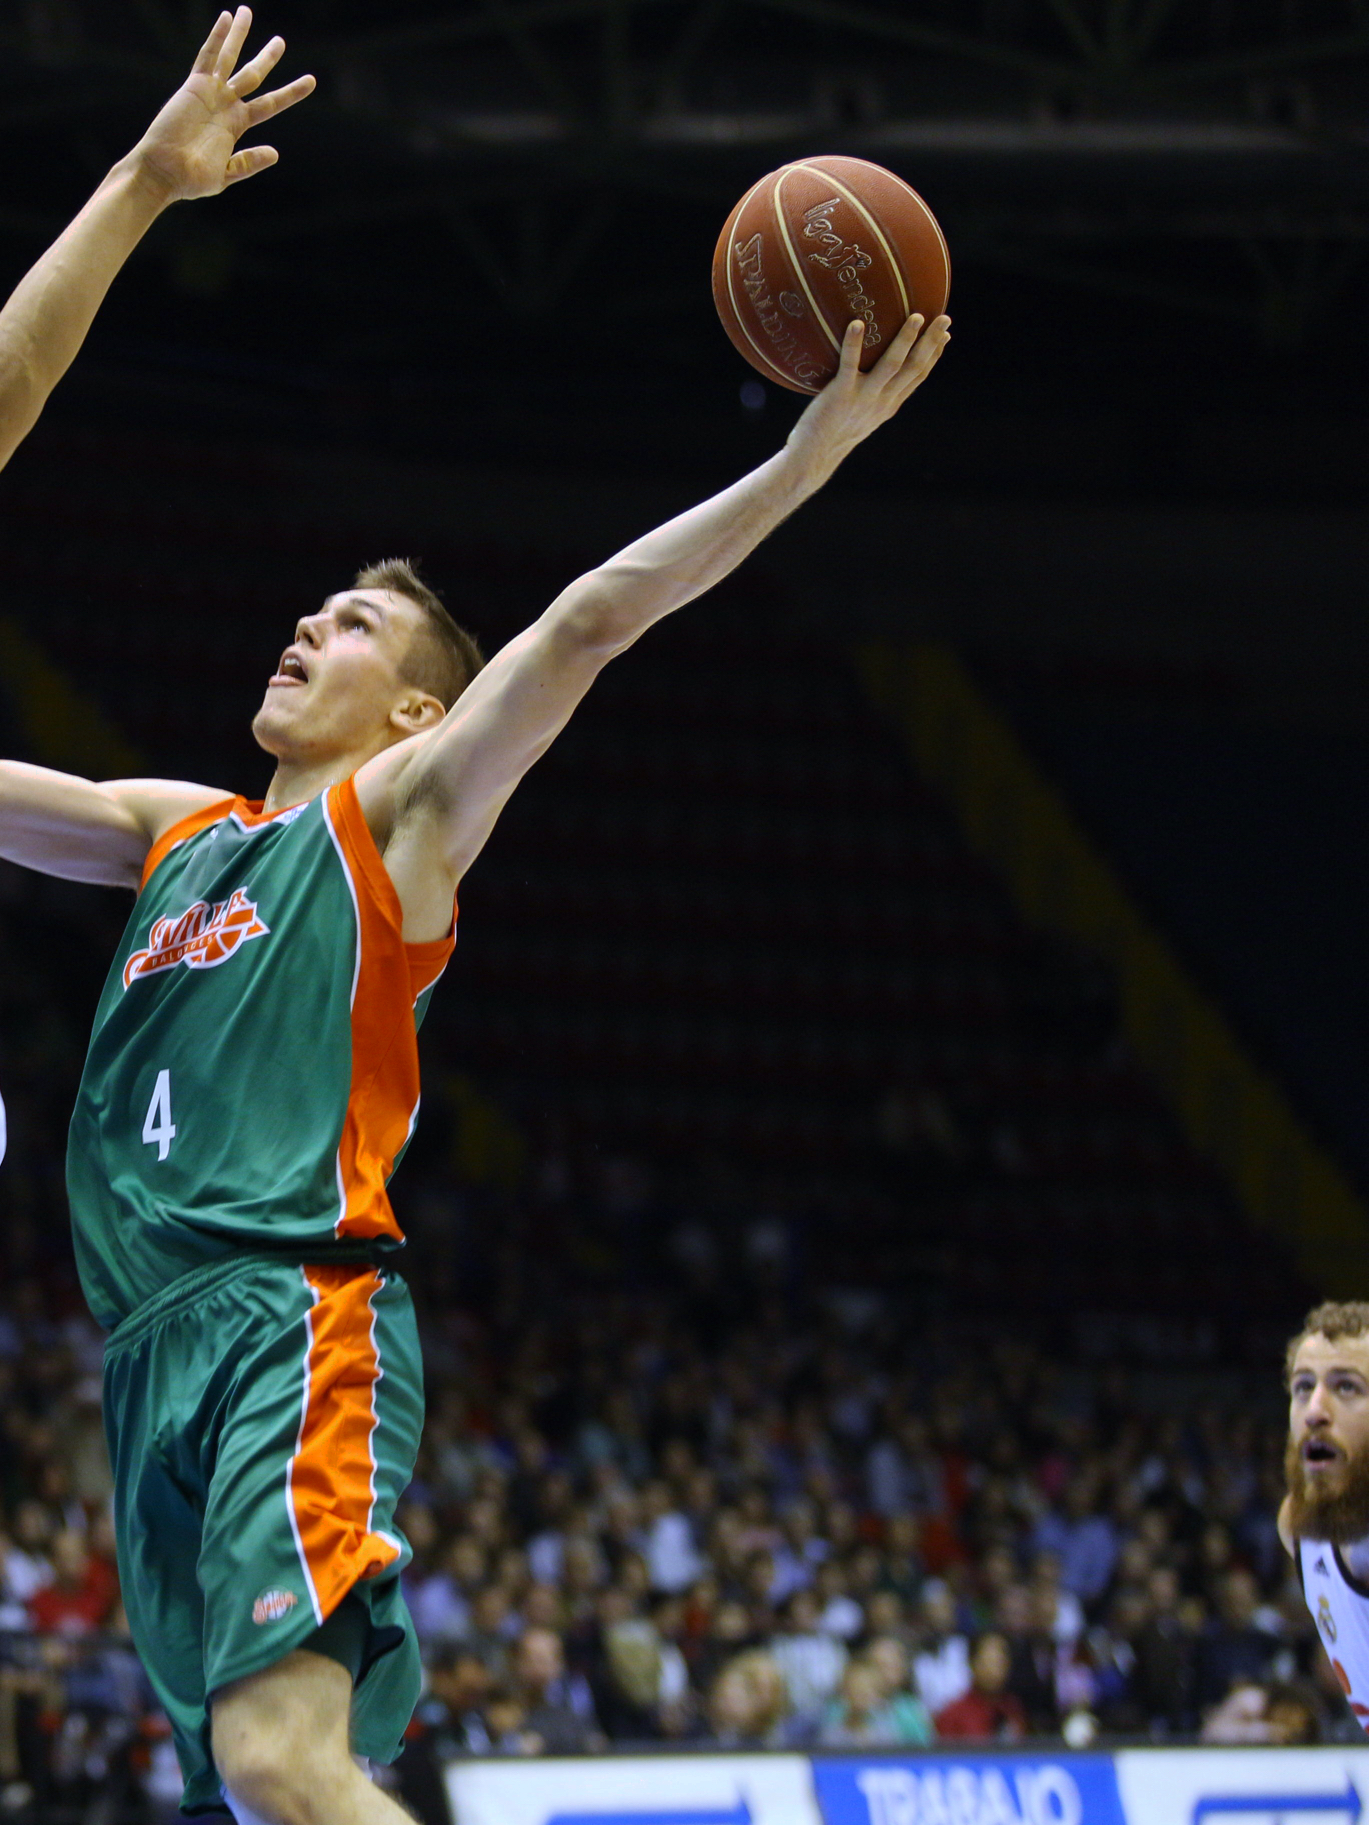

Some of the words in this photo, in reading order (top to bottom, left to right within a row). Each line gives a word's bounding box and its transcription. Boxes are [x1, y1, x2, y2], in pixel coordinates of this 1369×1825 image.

[734, 232, 832, 386] SPALDING
[142, 1069, 176, 1162] 4
[854, 1765, 1083, 1825] TRABAJO
